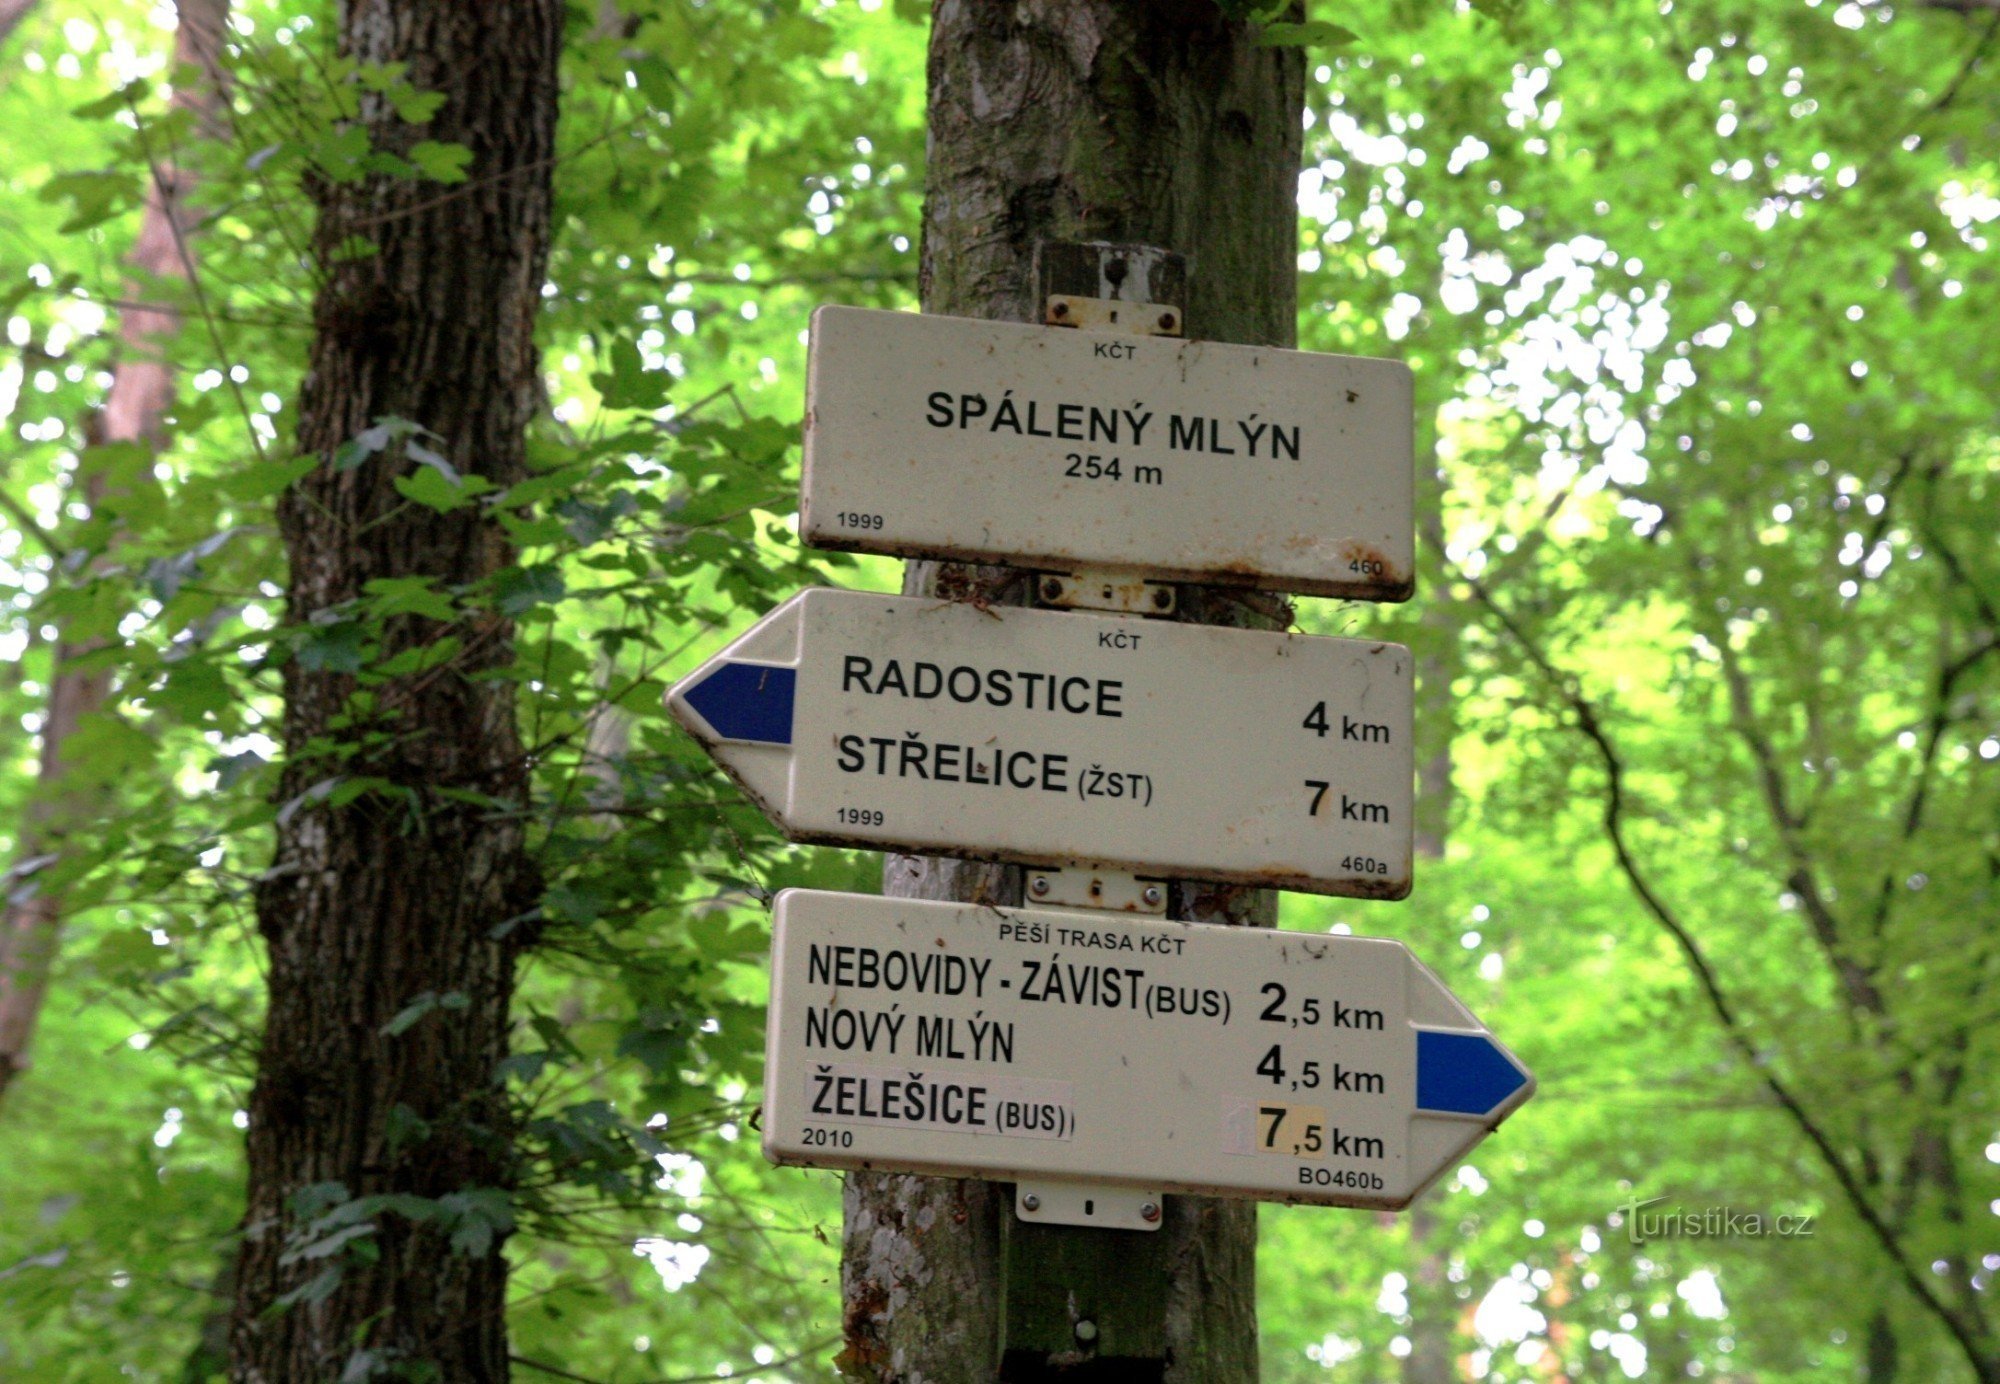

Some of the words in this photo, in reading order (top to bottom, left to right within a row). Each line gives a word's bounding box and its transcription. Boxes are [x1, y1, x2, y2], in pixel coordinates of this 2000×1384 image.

[1094, 340, 1137, 361] KČT
[926, 389, 1153, 447] SPÁLENÝ
[1168, 412, 1302, 461] MLÝN
[1064, 452, 1122, 482] 254
[1133, 462, 1164, 485] m
[836, 511, 884, 530] 1999
[1348, 558, 1384, 576] 460
[1098, 628, 1142, 651] KČT
[842, 655, 1124, 718] RADOSTICE
[1302, 700, 1330, 738] 4
[1341, 714, 1390, 744] km
[836, 730, 1069, 793] STŘELICE
[1077, 764, 1154, 808] (ŽST)
[1303, 779, 1330, 817] 7
[1340, 794, 1390, 824] km
[836, 807, 885, 828] 1999
[1340, 856, 1388, 875] 460a
[998, 921, 1053, 946] PĚŠÍ
[1058, 927, 1135, 952] TRASA
[1140, 930, 1186, 957] KČT
[807, 943, 992, 1000] NEBOVIDY
[1258, 982, 1322, 1028] 2,5
[1332, 999, 1385, 1031] km
[805, 1003, 905, 1055] NOVÝ
[915, 1008, 1015, 1063] MLÝN
[1255, 1044, 1322, 1094] 4,5
[1332, 1063, 1385, 1094] km
[811, 1064, 987, 1125] ŽELEŠICE
[1258, 1106, 1322, 1156] 7,5
[1332, 1127, 1385, 1159] km
[801, 1127, 854, 1150] 2010
